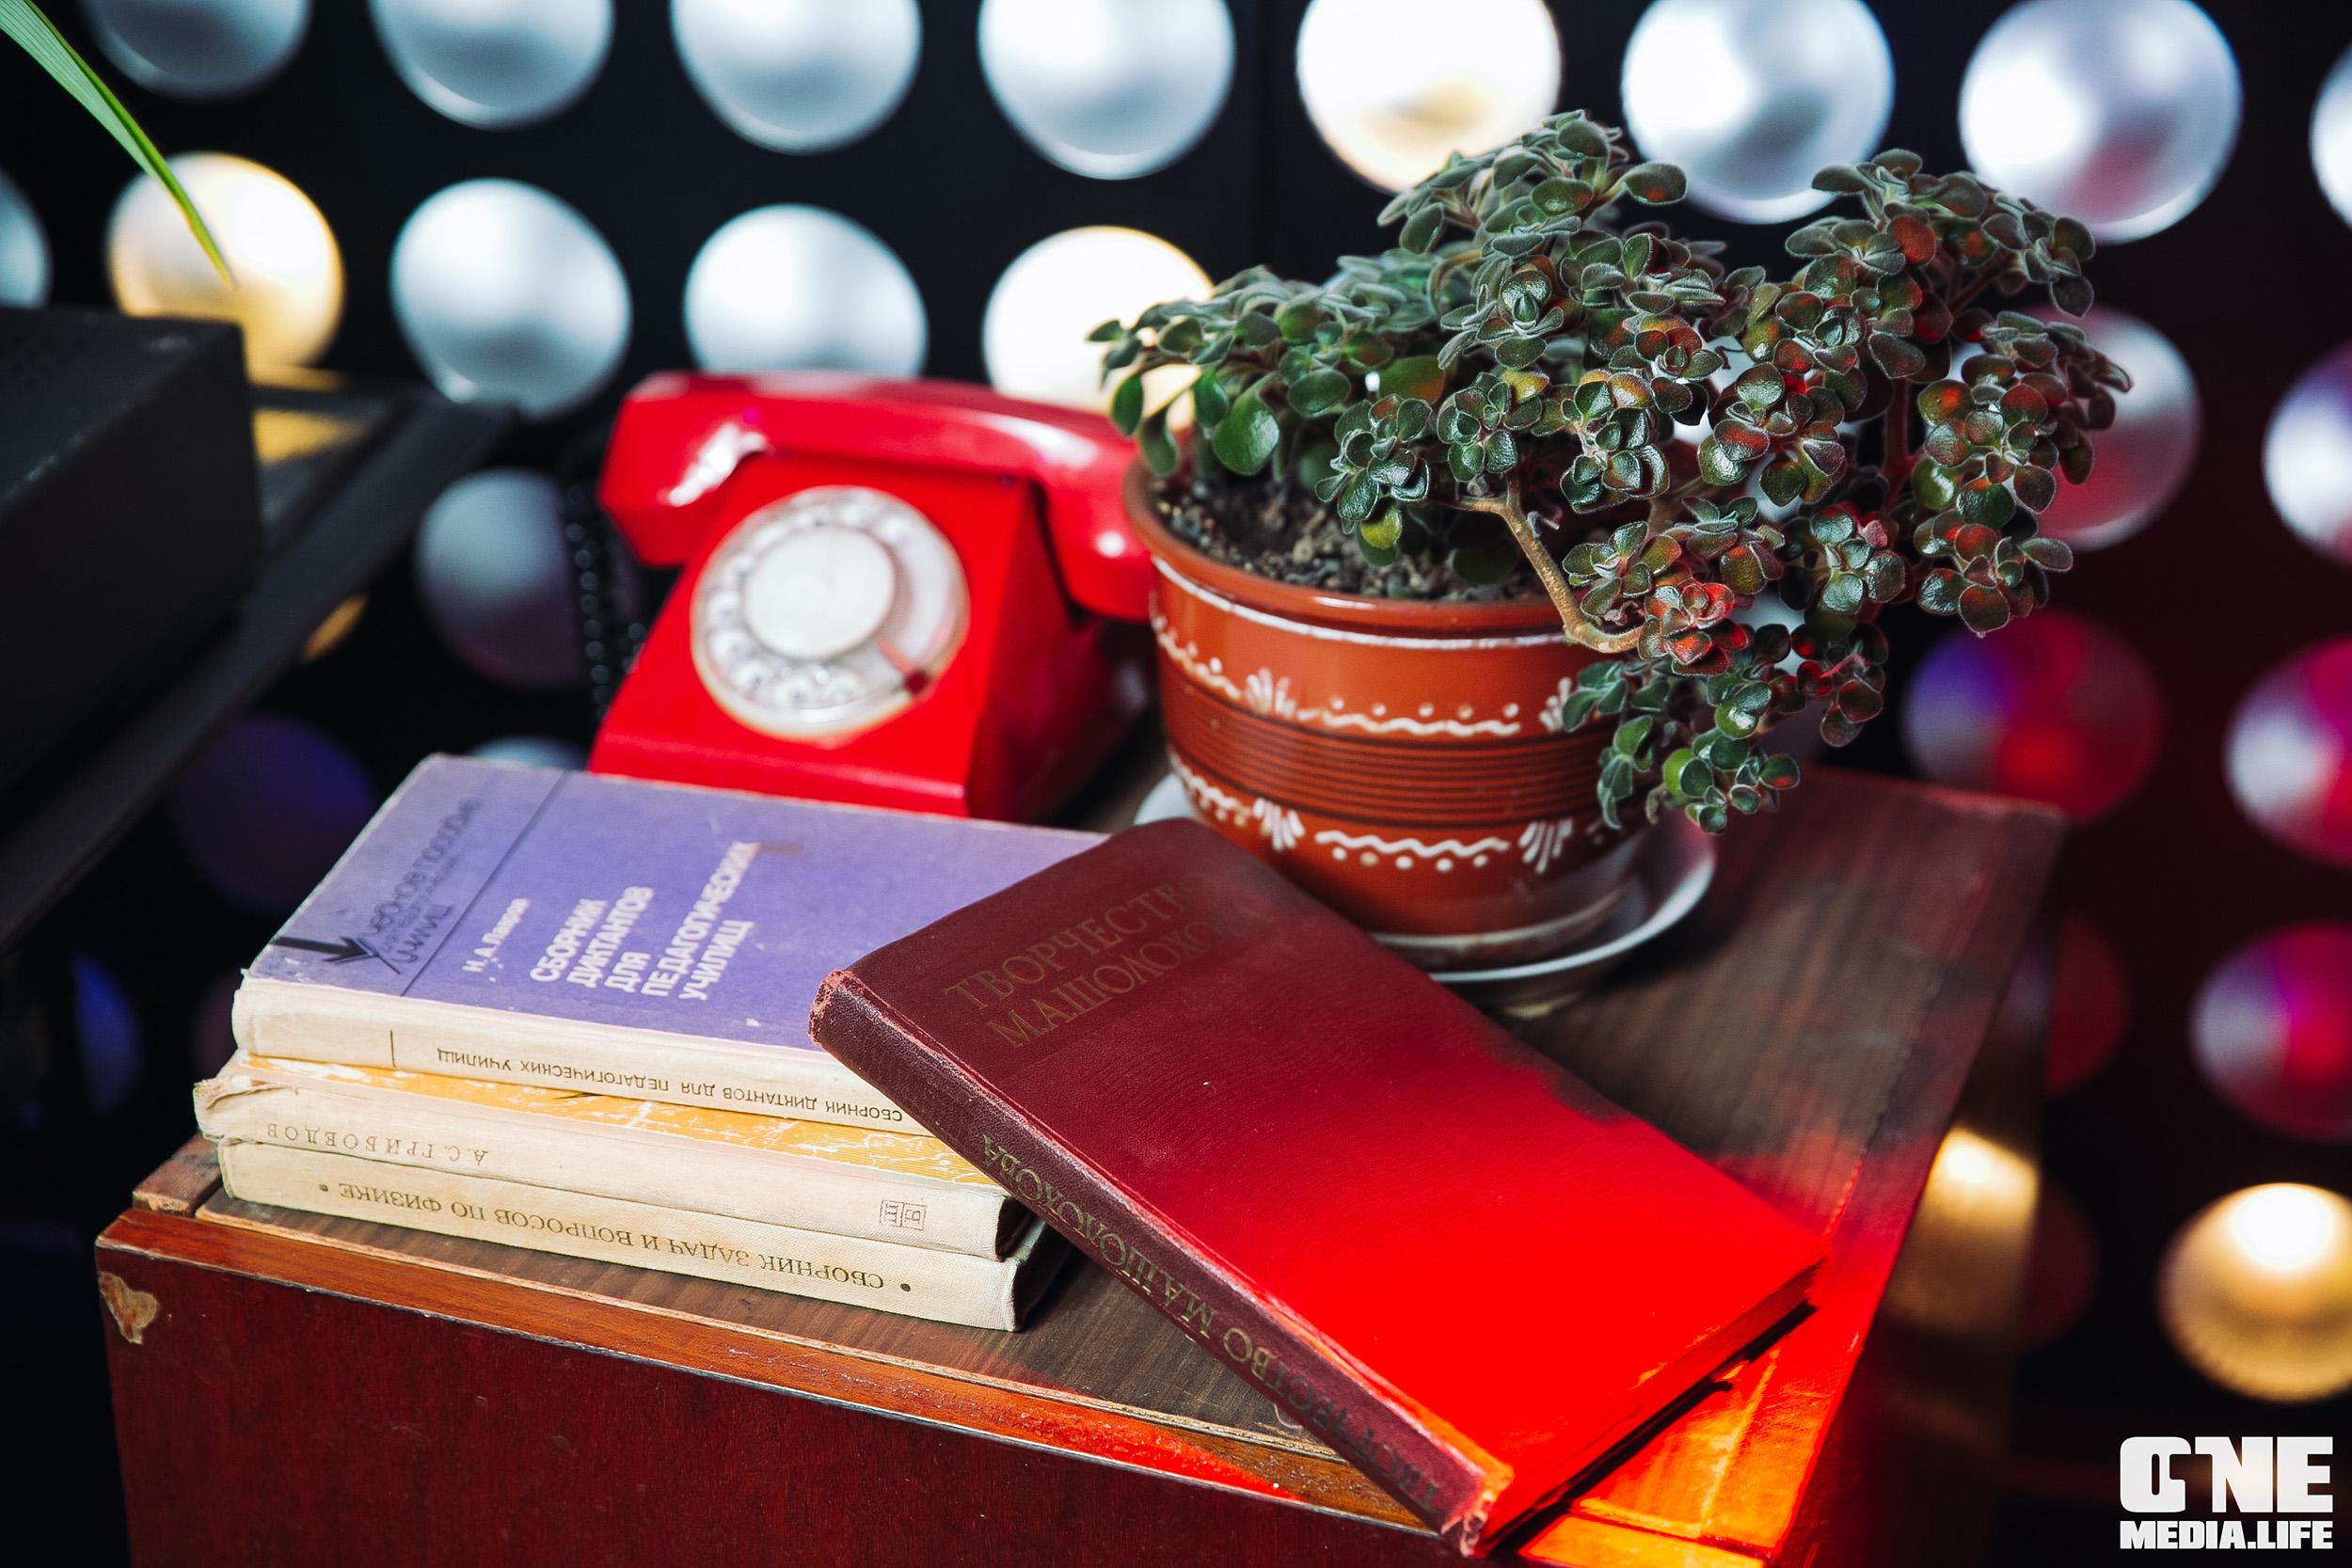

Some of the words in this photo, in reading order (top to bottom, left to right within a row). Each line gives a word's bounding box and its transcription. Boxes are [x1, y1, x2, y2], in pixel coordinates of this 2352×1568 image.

[529, 897, 608, 982] СБОРНИК
[565, 885, 655, 989] ДИКТАНТОВ
[604, 950, 652, 993] ДЛЯ
[677, 919, 755, 1001] УЧИЛИЩ
[437, 1047, 513, 1071] УЧИЛИЩ
[519, 1059, 669, 1091] ПЕДАГОГИЧЕСКИХ
[680, 1081, 716, 1098] ДЛЯ
[723, 1086, 818, 1111] ДИКТАНТОВ
[825, 1100, 904, 1122] СБОРНИК
[338, 1181, 443, 1212] ФИЗИКЕ
[450, 1200, 486, 1222] ПО
[494, 1208, 635, 1247] ВОПРОСОВ
[640, 1232, 660, 1251] И
[668, 1238, 750, 1267] ЗАДАЧ
[758, 1253, 885, 1290] СБОРНИК
